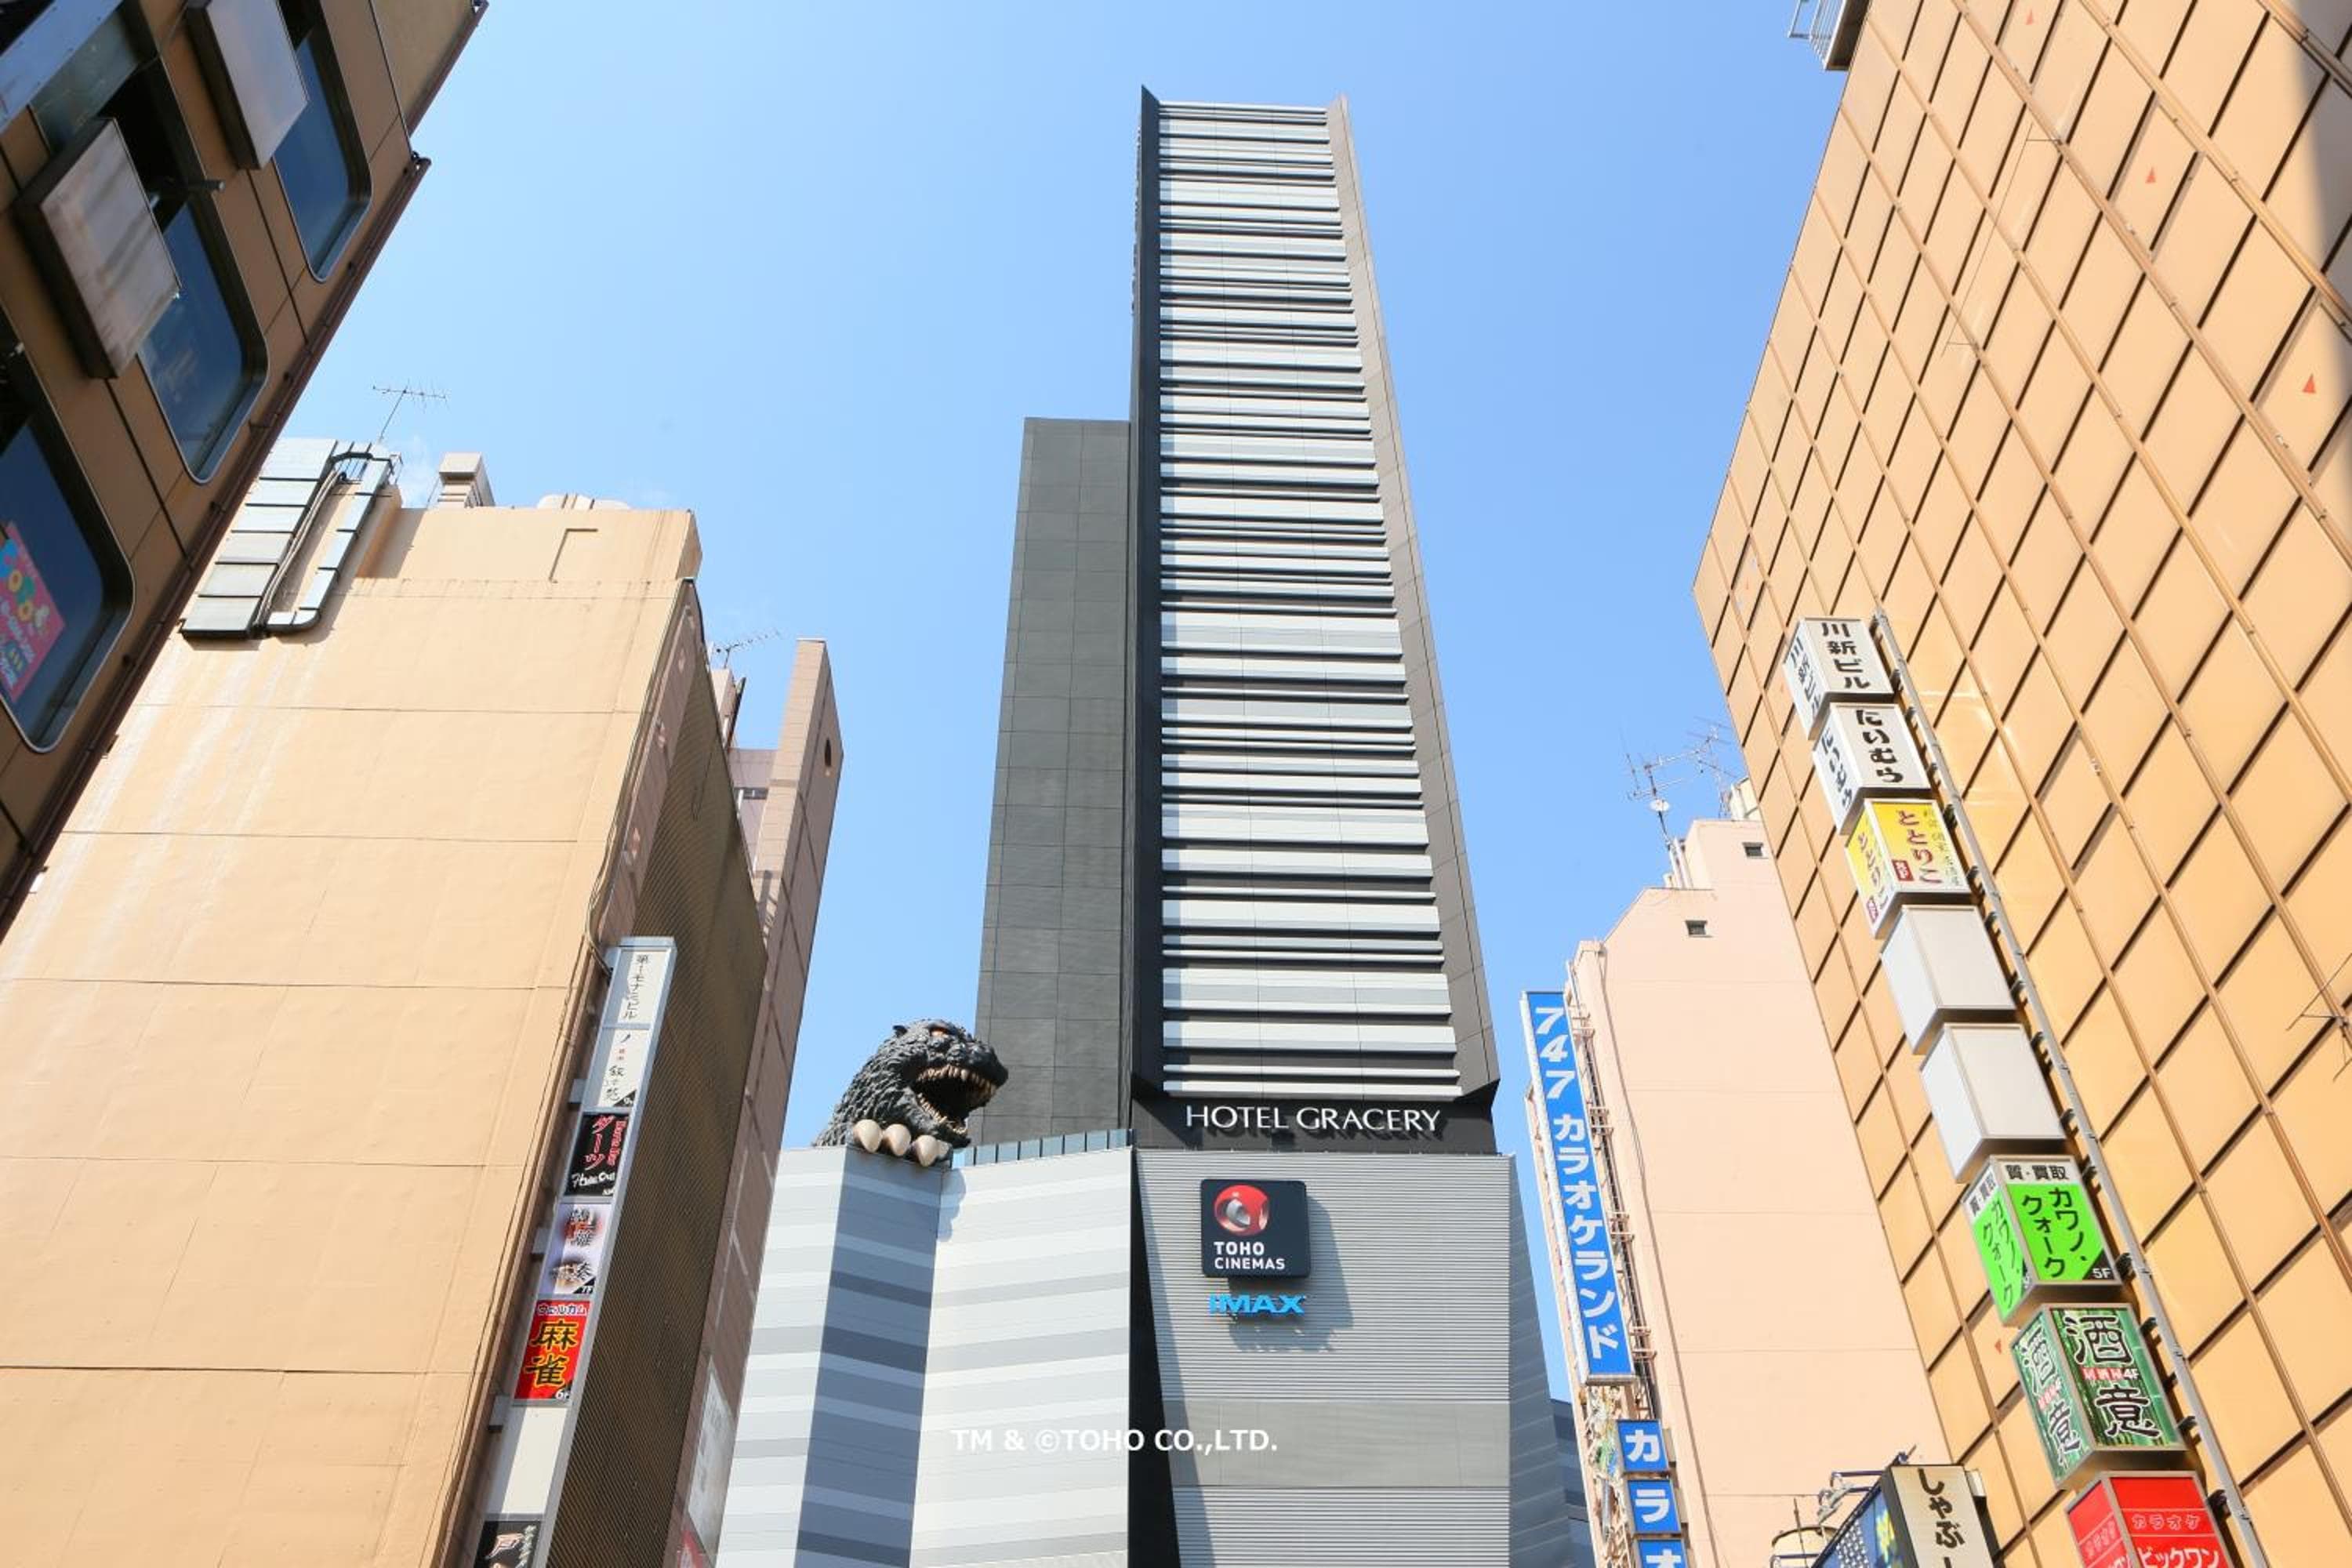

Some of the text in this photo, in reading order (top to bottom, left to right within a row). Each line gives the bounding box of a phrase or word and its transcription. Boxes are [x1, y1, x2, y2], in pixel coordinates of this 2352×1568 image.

[1821, 622, 1871, 689] 川新ビル
[1857, 710, 1904, 784] にいむら
[1186, 1105, 1441, 1131] HOTEL GRACERY
[1535, 1007, 1620, 1360] 747 カラオケランド
[1214, 1241, 1265, 1255] TOHO
[2021, 1195, 2065, 1278] クォーク
[1214, 1257, 1286, 1270] CINEMAS
[2092, 1268, 2111, 1279] 5F
[1208, 1293, 1307, 1316] IMAX
[524, 1319, 579, 1388] 麻雀
[2137, 1546, 2220, 1568] ビックワン
